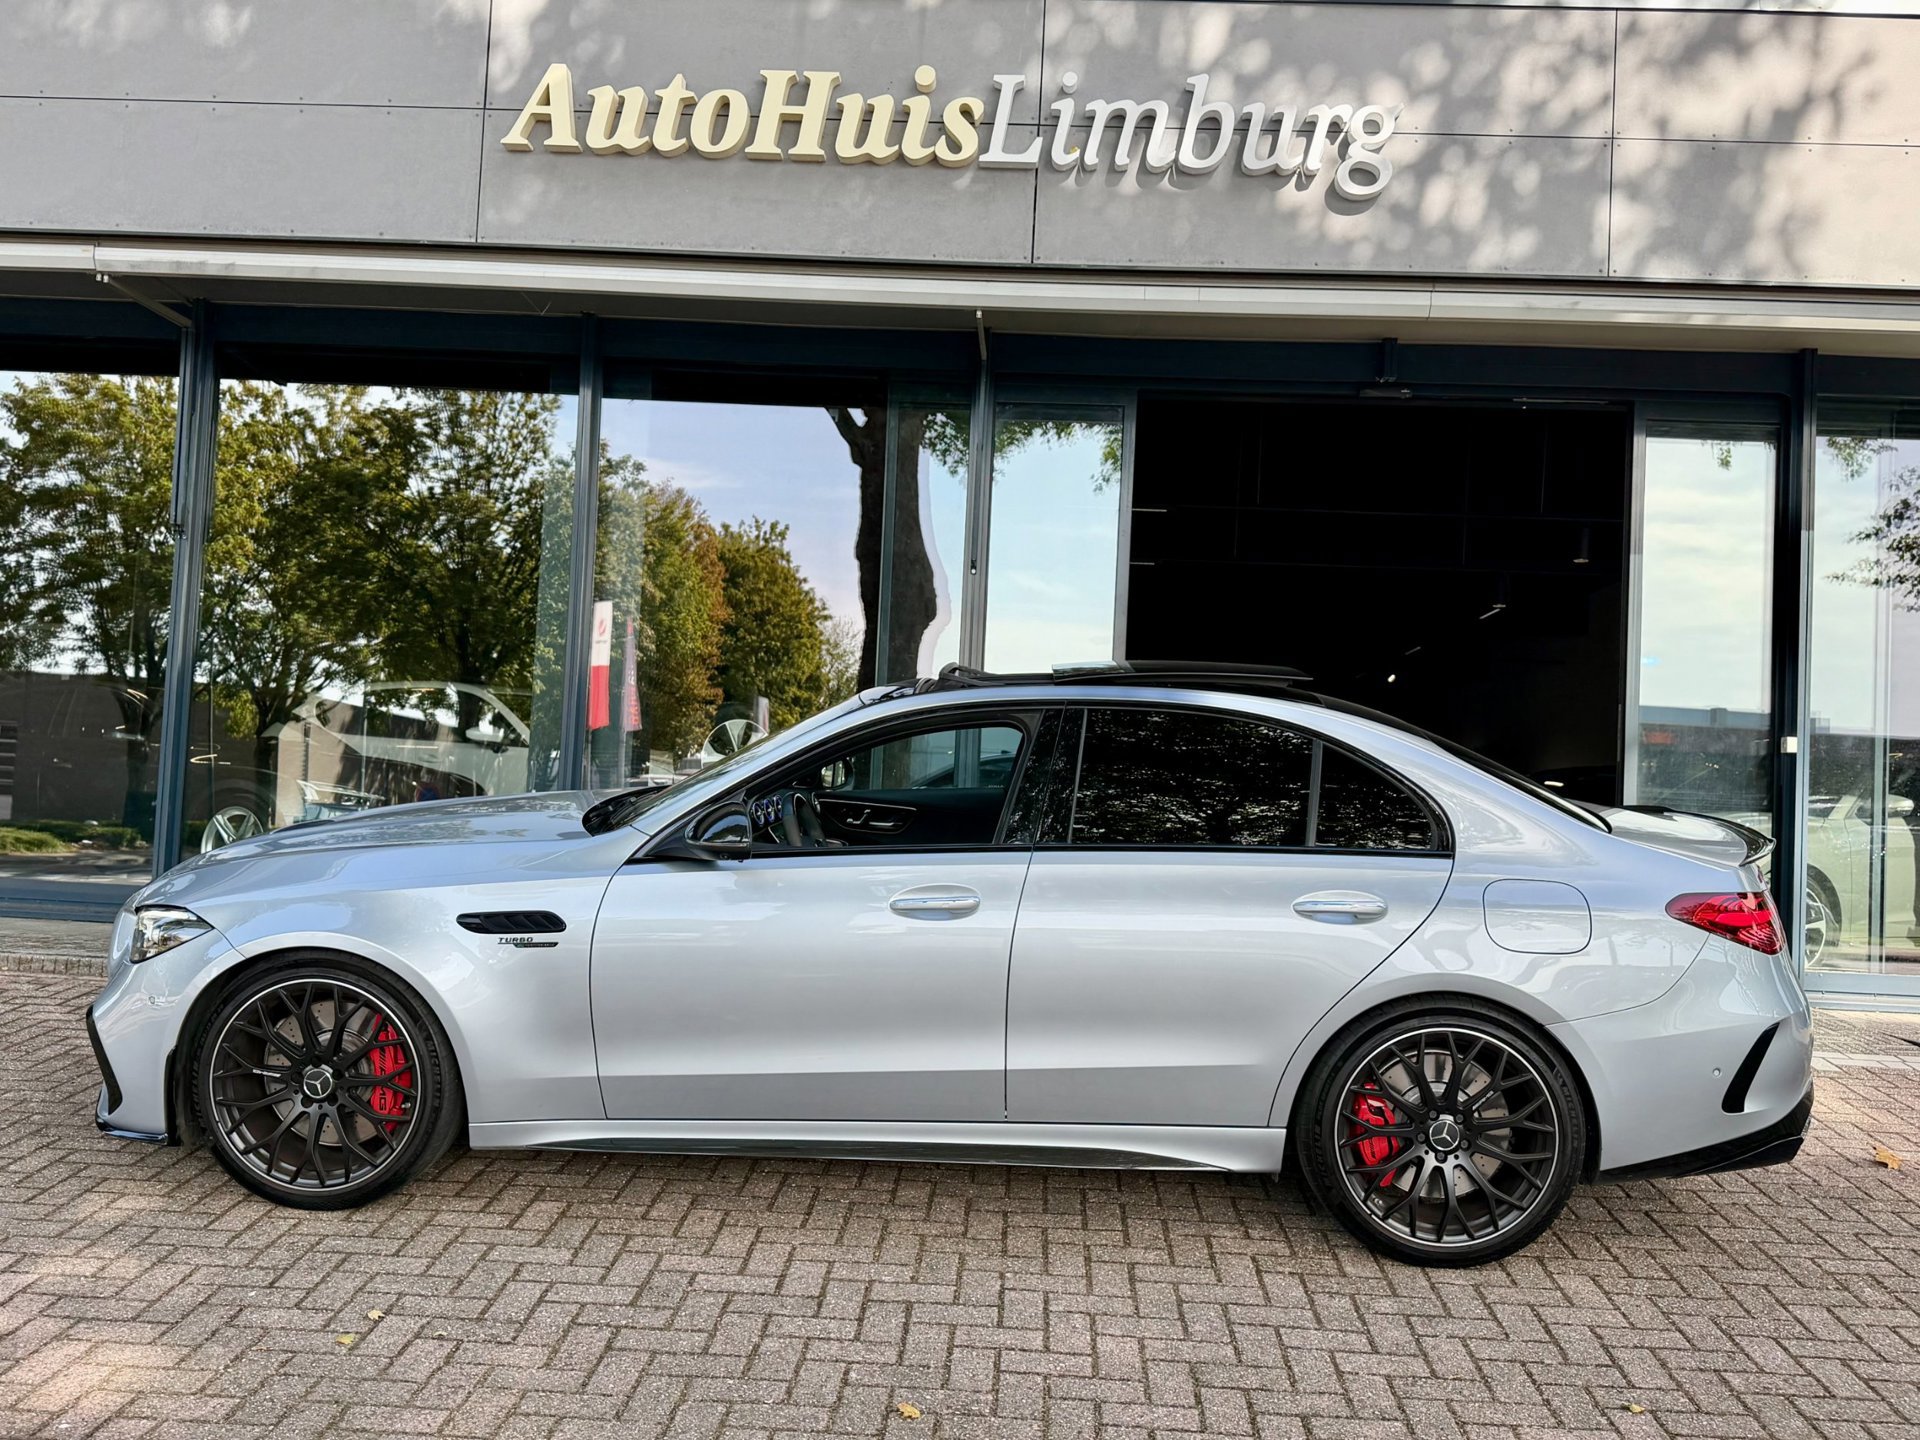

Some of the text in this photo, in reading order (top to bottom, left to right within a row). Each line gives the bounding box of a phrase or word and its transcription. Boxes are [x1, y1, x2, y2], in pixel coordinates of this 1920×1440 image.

[501, 63, 1403, 200] AutoHuisLimburg
[425, 1040, 441, 1108] MICHELIN
[1562, 1087, 1579, 1148] MICHELIN
